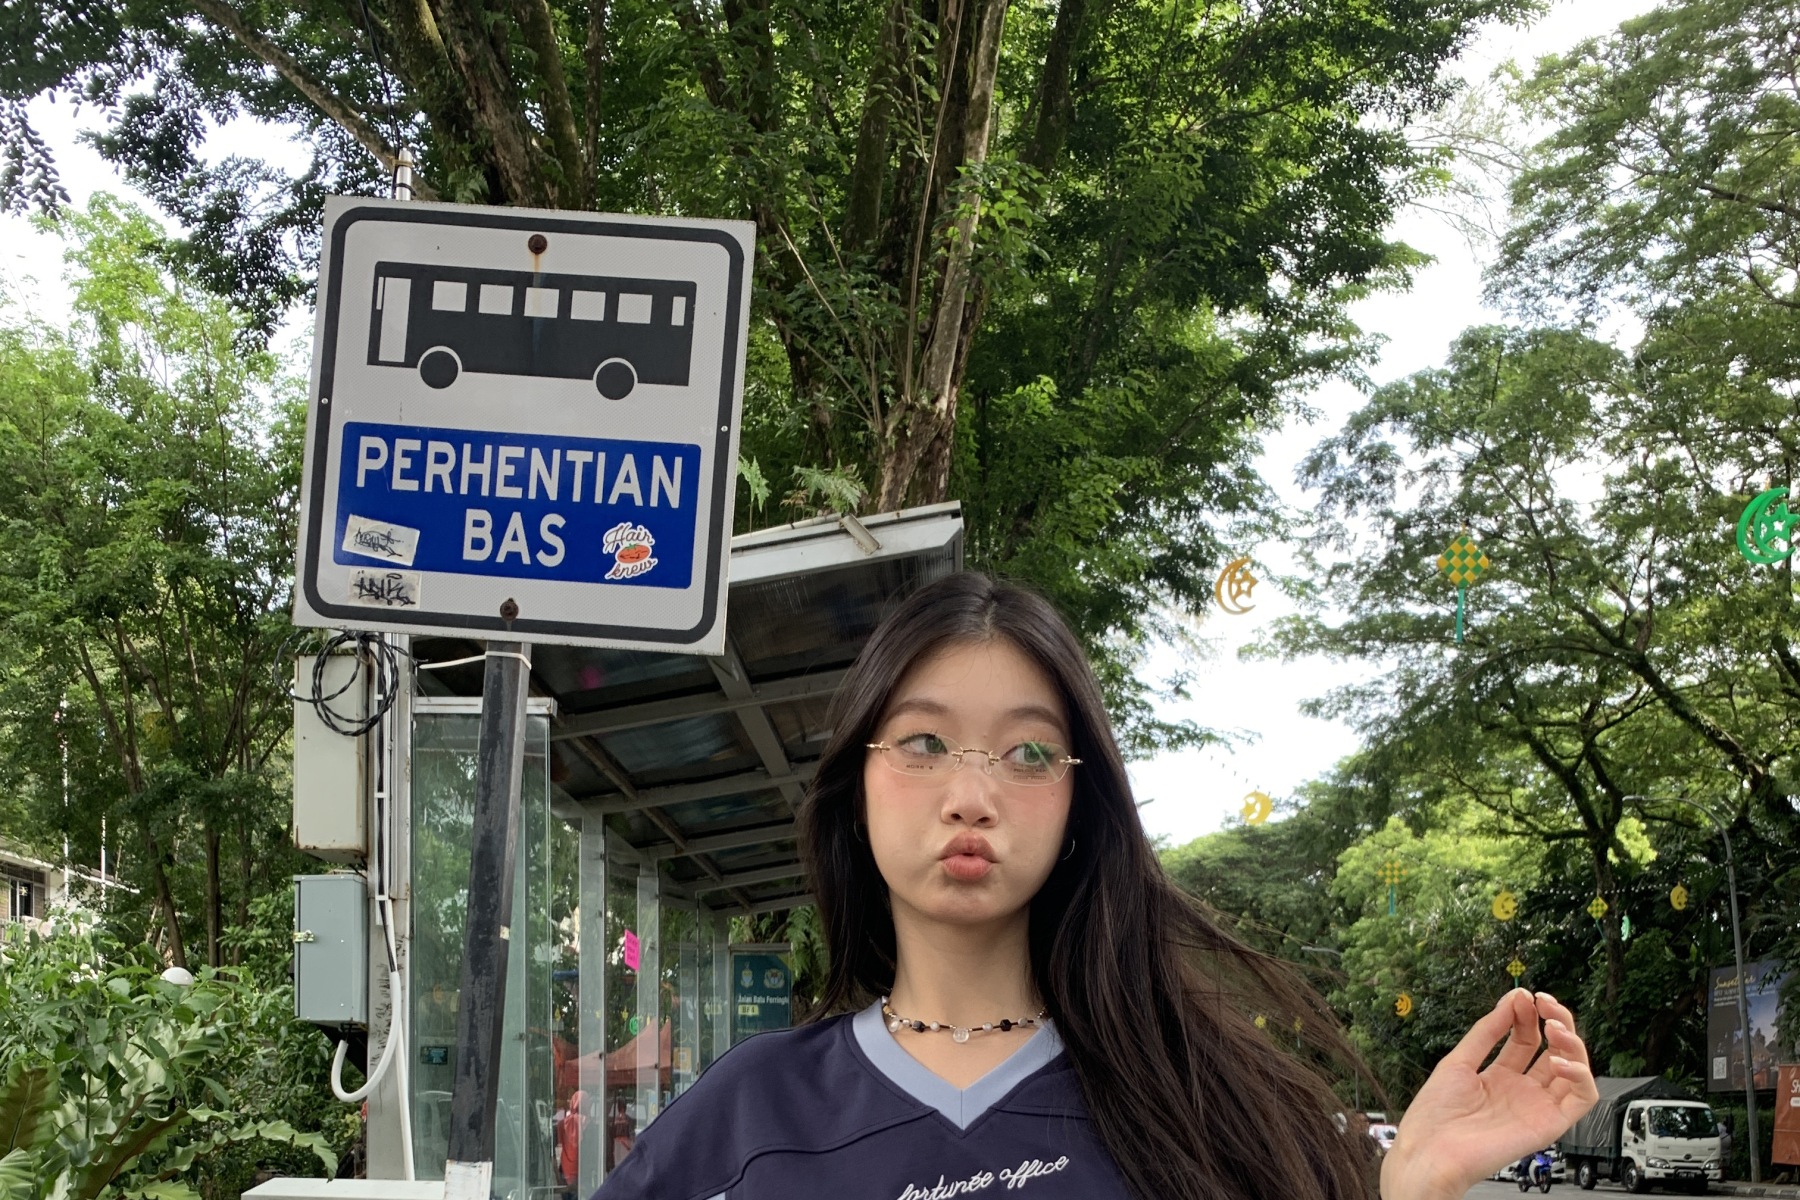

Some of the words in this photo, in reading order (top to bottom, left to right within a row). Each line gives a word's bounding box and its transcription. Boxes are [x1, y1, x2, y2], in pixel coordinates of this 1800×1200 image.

[356, 435, 683, 510] PERHENTIAN
[462, 508, 567, 568] BAS
[605, 524, 654, 552] Hair
[607, 559, 657, 577] knew
[999, 1155, 1070, 1189] office
